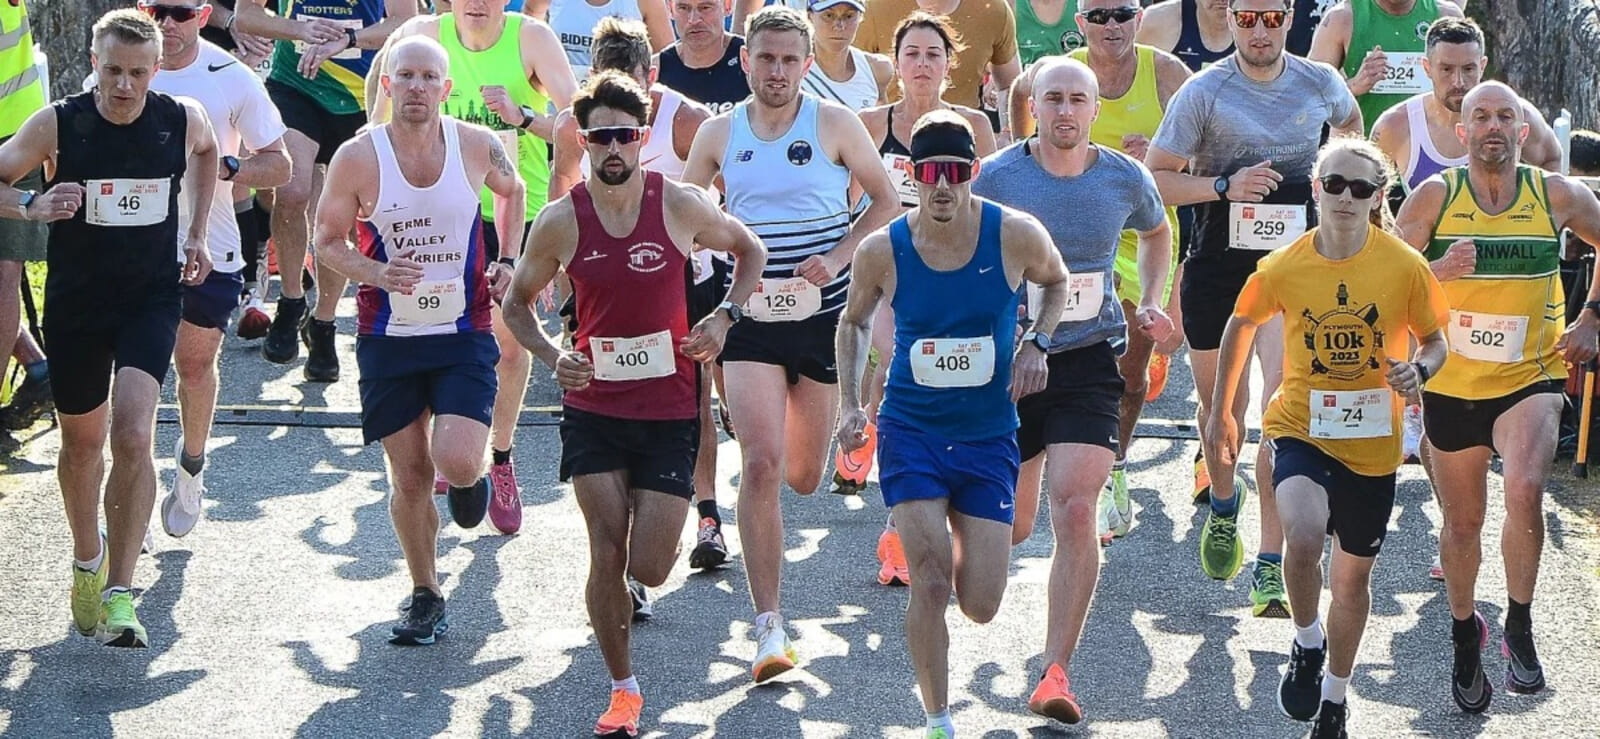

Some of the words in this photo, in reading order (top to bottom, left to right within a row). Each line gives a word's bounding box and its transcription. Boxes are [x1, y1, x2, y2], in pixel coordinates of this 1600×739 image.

[302, 5, 353, 15] TROTTERS
[1387, 67, 1414, 80] 324
[117, 195, 140, 210] 46
[392, 217, 432, 233] ERME
[1253, 220, 1285, 236] 259
[393, 235, 446, 249] VALLEY
[408, 252, 461, 263] RRIERS
[1476, 243, 1537, 260] RNWALL
[418, 296, 440, 309] 99
[764, 294, 796, 308] 126
[1323, 331, 1366, 350] 10k
[1470, 330, 1504, 347] 502
[615, 350, 649, 367] 400
[935, 355, 970, 371] 408
[1330, 352, 1360, 361] 2023
[1342, 408, 1363, 422] 74
